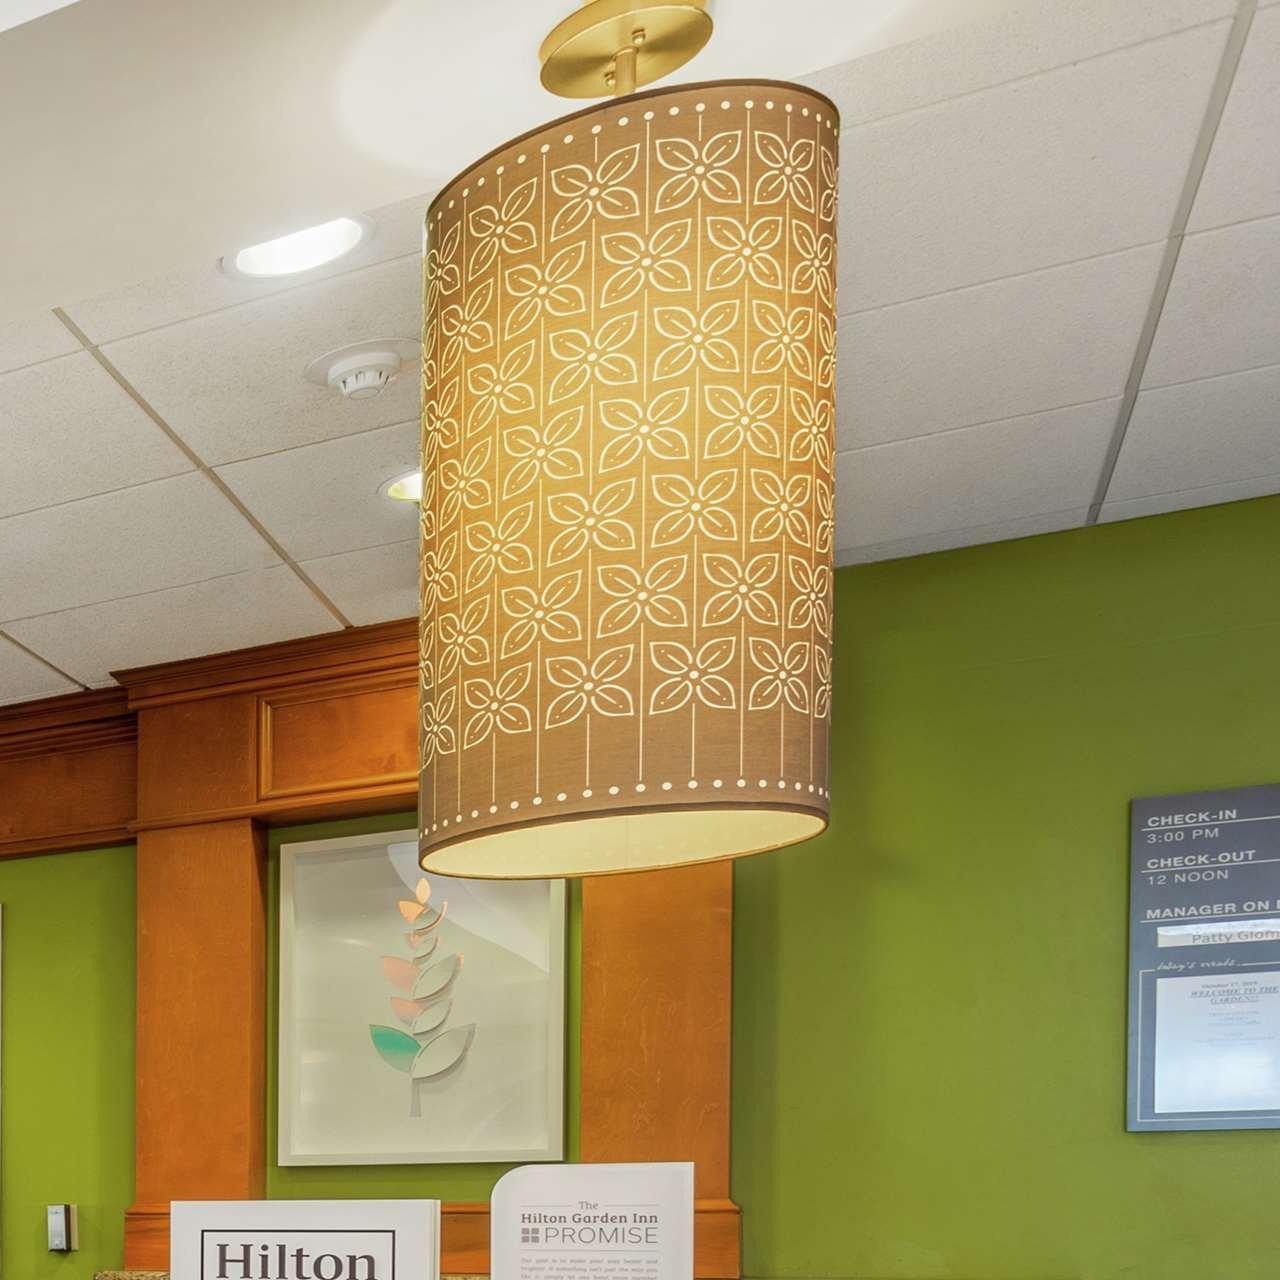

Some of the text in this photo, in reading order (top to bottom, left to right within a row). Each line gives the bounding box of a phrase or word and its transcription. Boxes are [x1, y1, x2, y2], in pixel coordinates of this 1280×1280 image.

[1147, 809, 1237, 827] CHECK-IN
[1147, 828, 1220, 844] 3:00 PM
[1146, 850, 1256, 869] CHECK-OUT
[1149, 870, 1229, 885] 12 NOON
[1146, 903, 1237, 919] MANAGER
[1243, 901, 1270, 912] ON
[1192, 932, 1233, 944] Patty
[578, 1200, 599, 1210] The
[521, 1212, 658, 1224] Hilton Garden Inn
[545, 1227, 658, 1244] PROMISE
